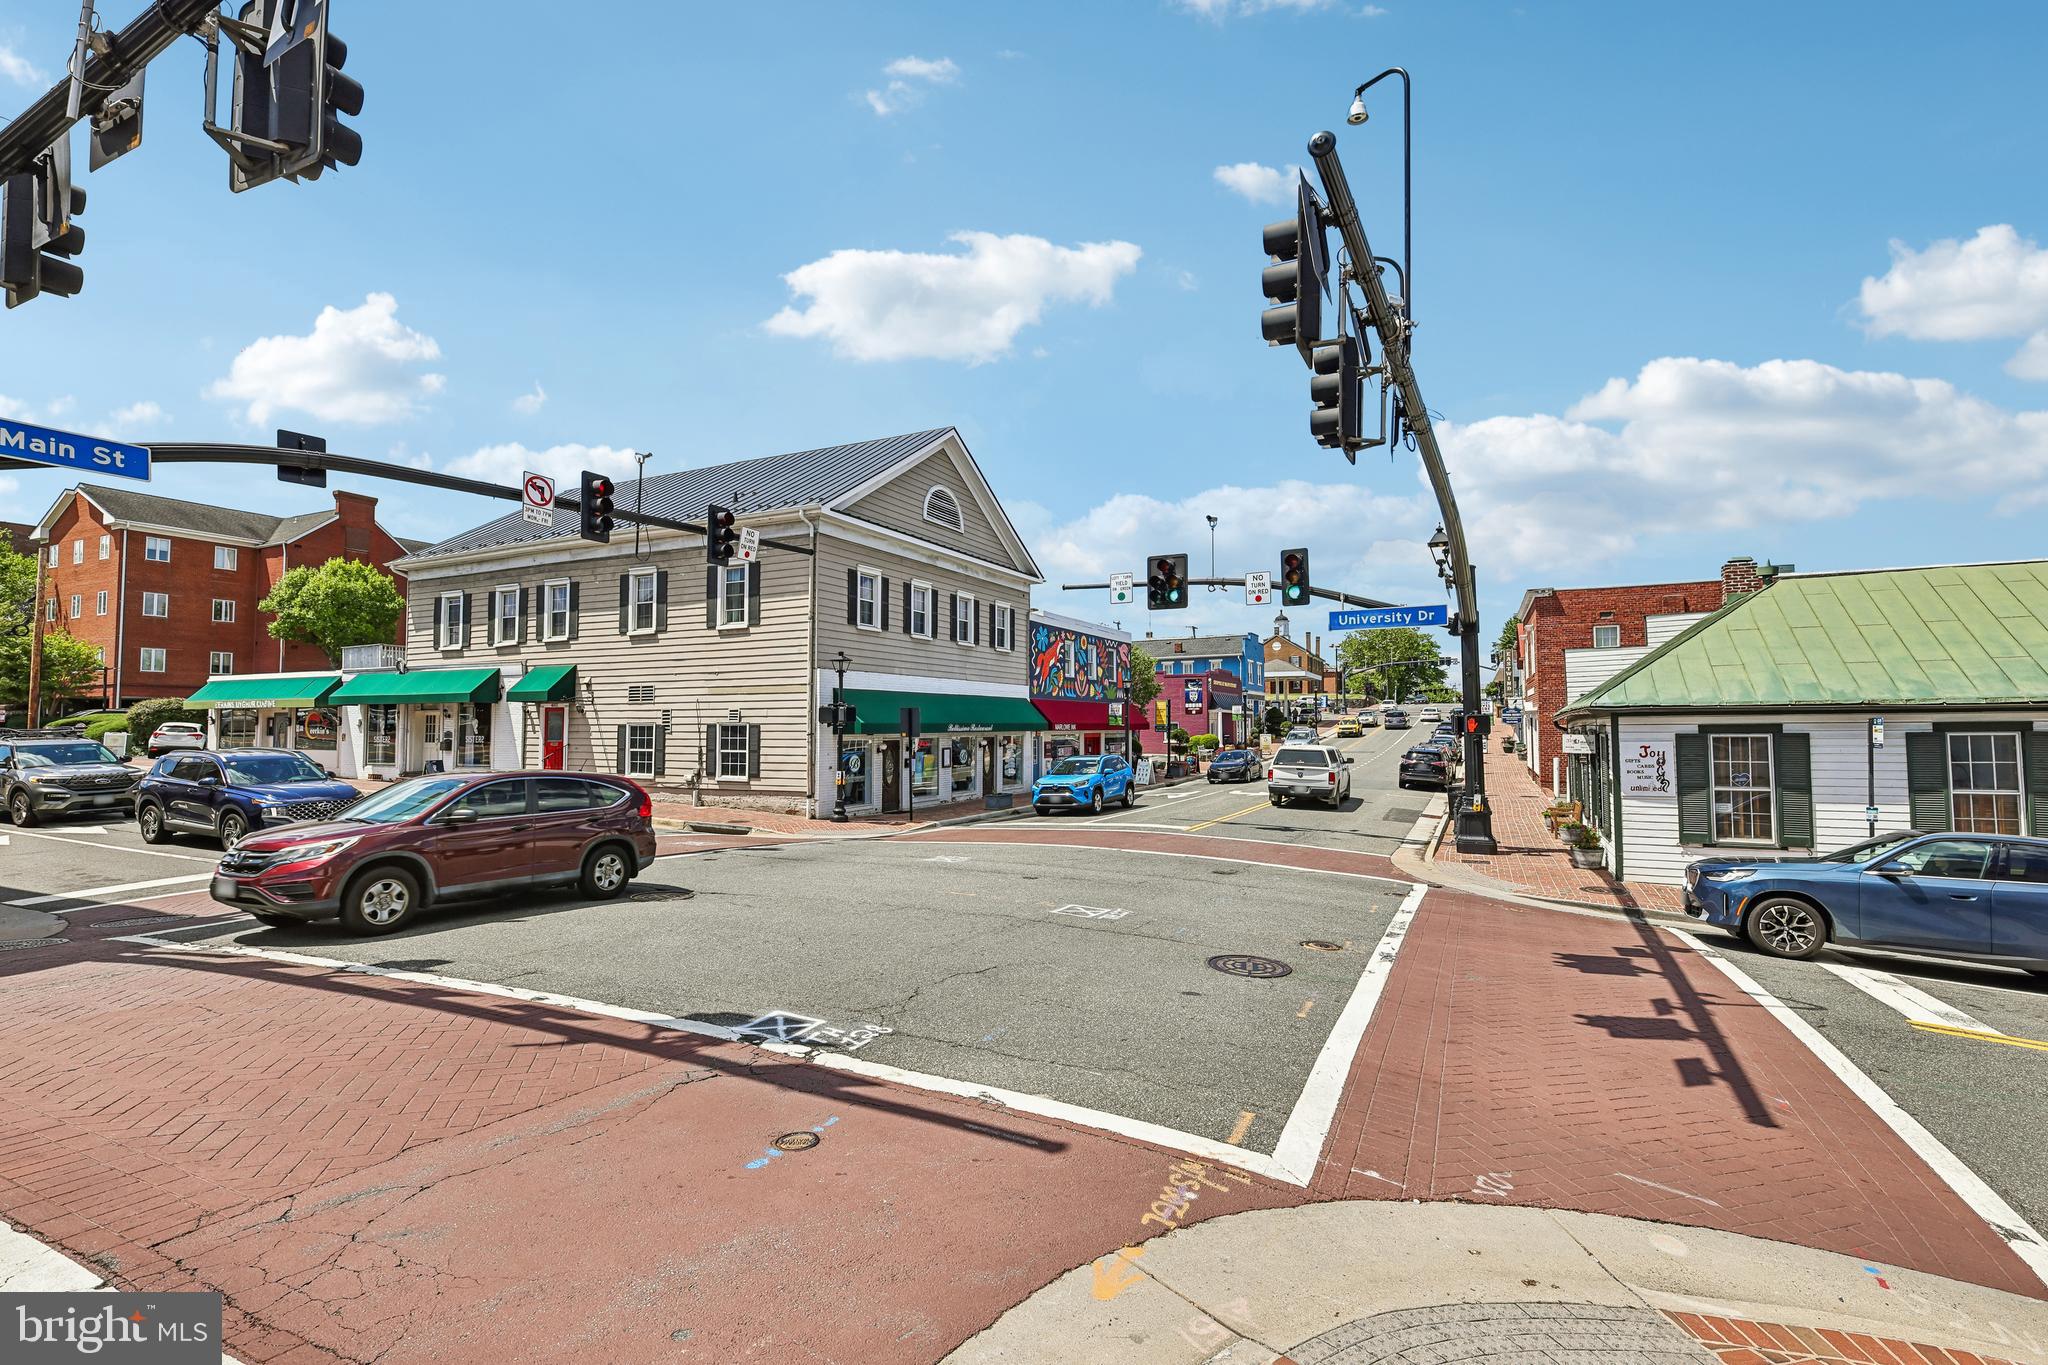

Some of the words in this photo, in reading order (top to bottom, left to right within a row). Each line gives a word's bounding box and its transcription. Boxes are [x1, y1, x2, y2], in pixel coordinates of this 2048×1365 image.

[0, 427, 76, 459] Main
[92, 446, 125, 468] St
[744, 537, 755, 545] TURN
[746, 530, 755, 538] NO
[1338, 611, 1412, 626] University
[1418, 610, 1435, 621] Dr
[1639, 745, 1666, 761] Joy
